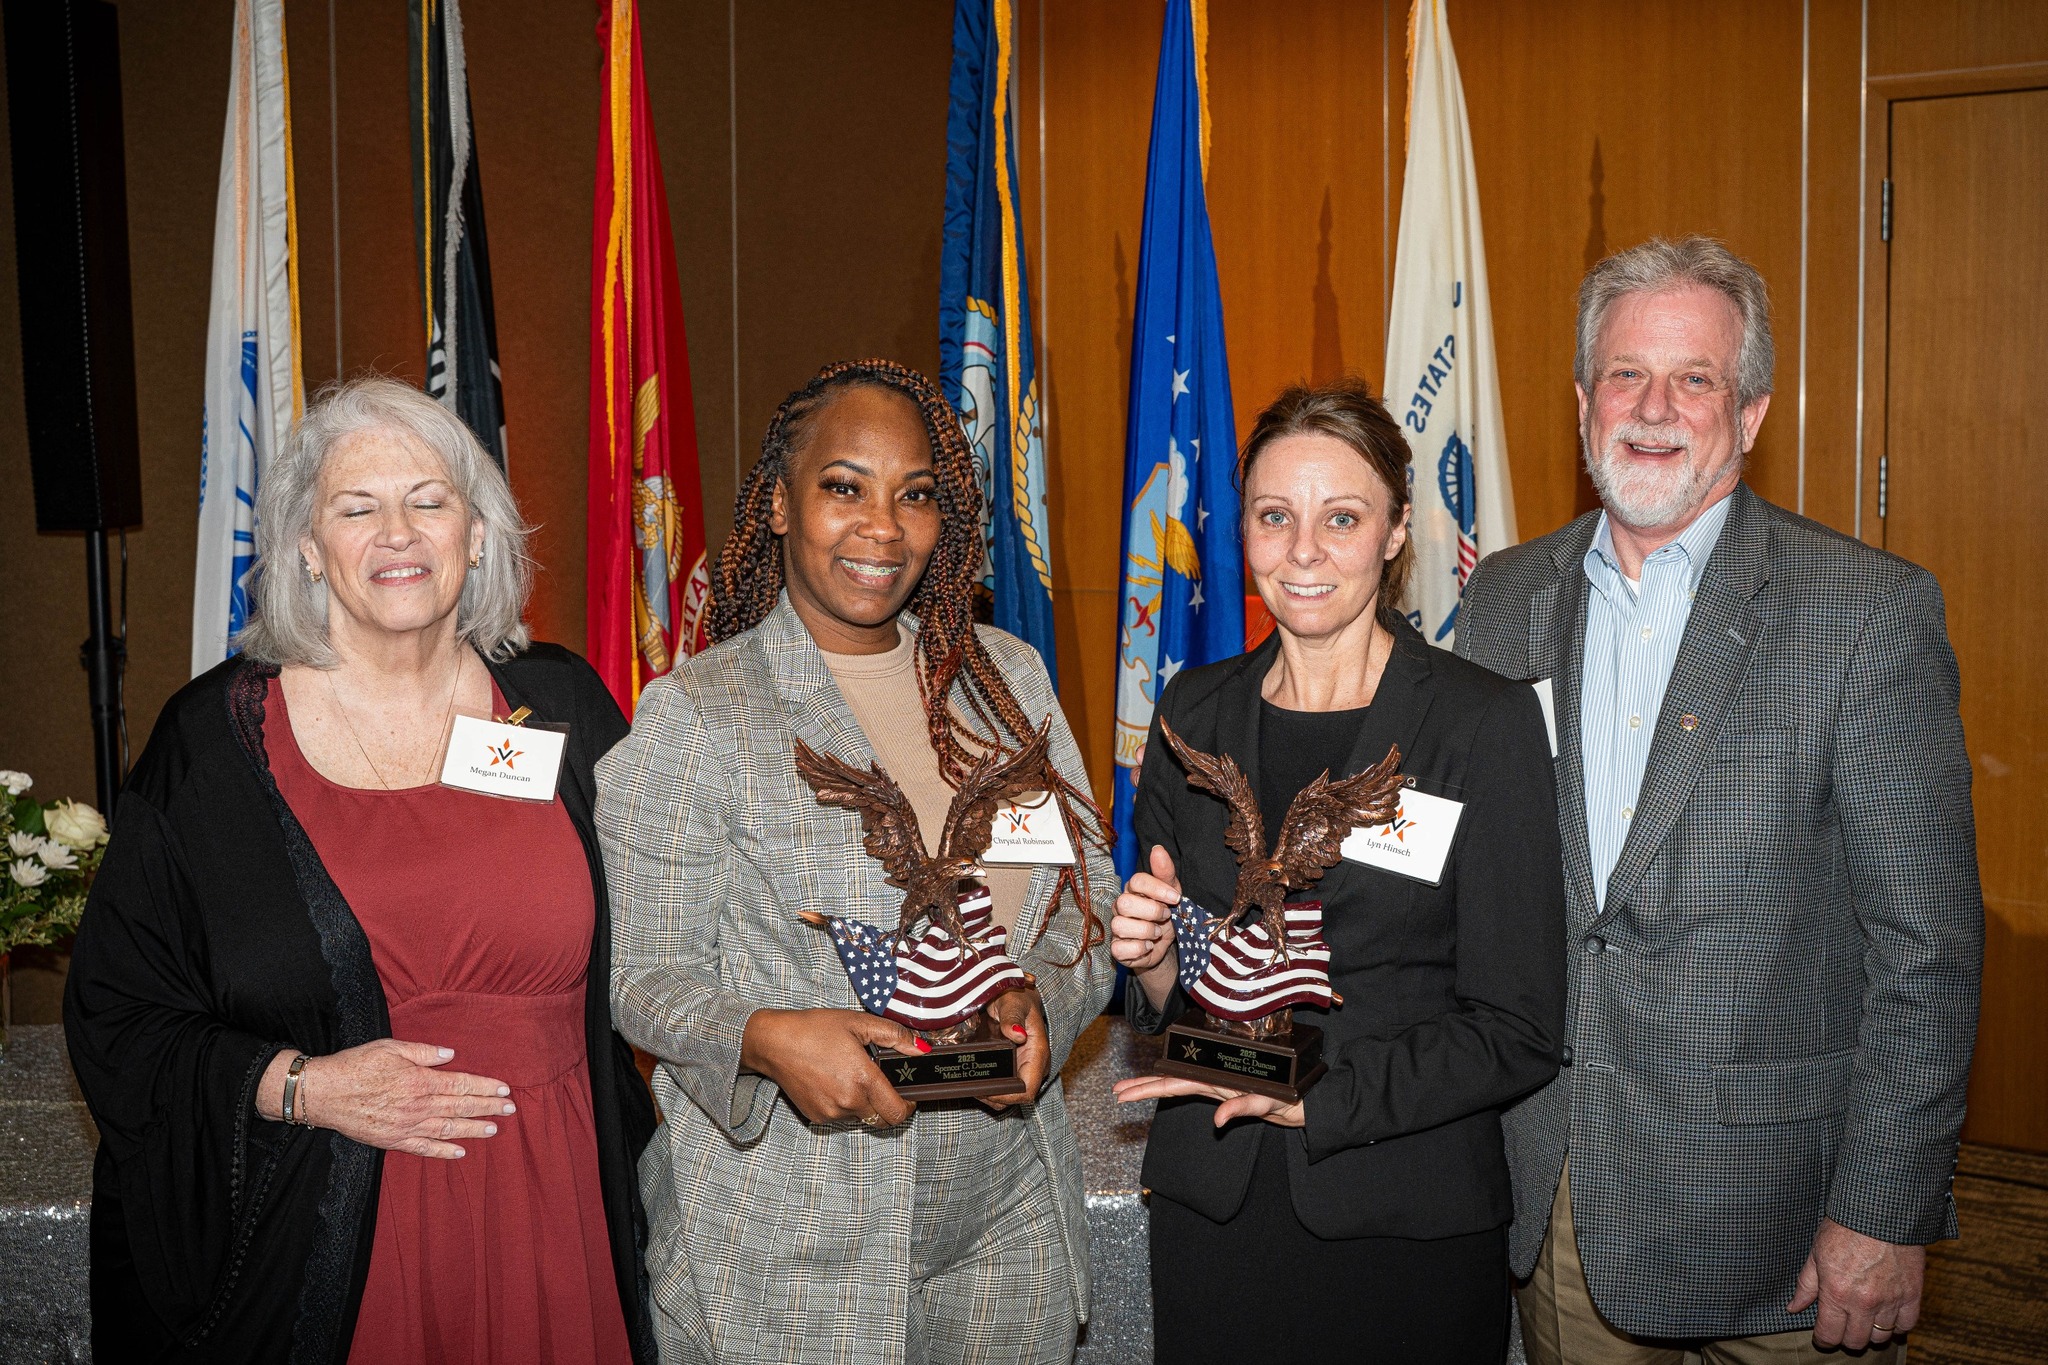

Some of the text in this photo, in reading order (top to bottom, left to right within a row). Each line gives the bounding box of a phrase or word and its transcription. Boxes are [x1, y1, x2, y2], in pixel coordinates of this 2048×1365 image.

[469, 765, 531, 783] Megan Duncan
[993, 836, 1055, 846] Chrystal Robinson
[1366, 838, 1411, 857] Lyn Hinsch
[957, 1054, 976, 1063] 2025
[1240, 1049, 1257, 1059] 2025
[934, 1064, 961, 1073] Spencer
[971, 1061, 998, 1070] Duncan
[1217, 1052, 1276, 1071] Spencer C. Duncan
[942, 1071, 962, 1079] Make
[968, 1069, 990, 1077] Count
[1223, 1061, 1242, 1071] Make
[1248, 1067, 1268, 1077] Count
